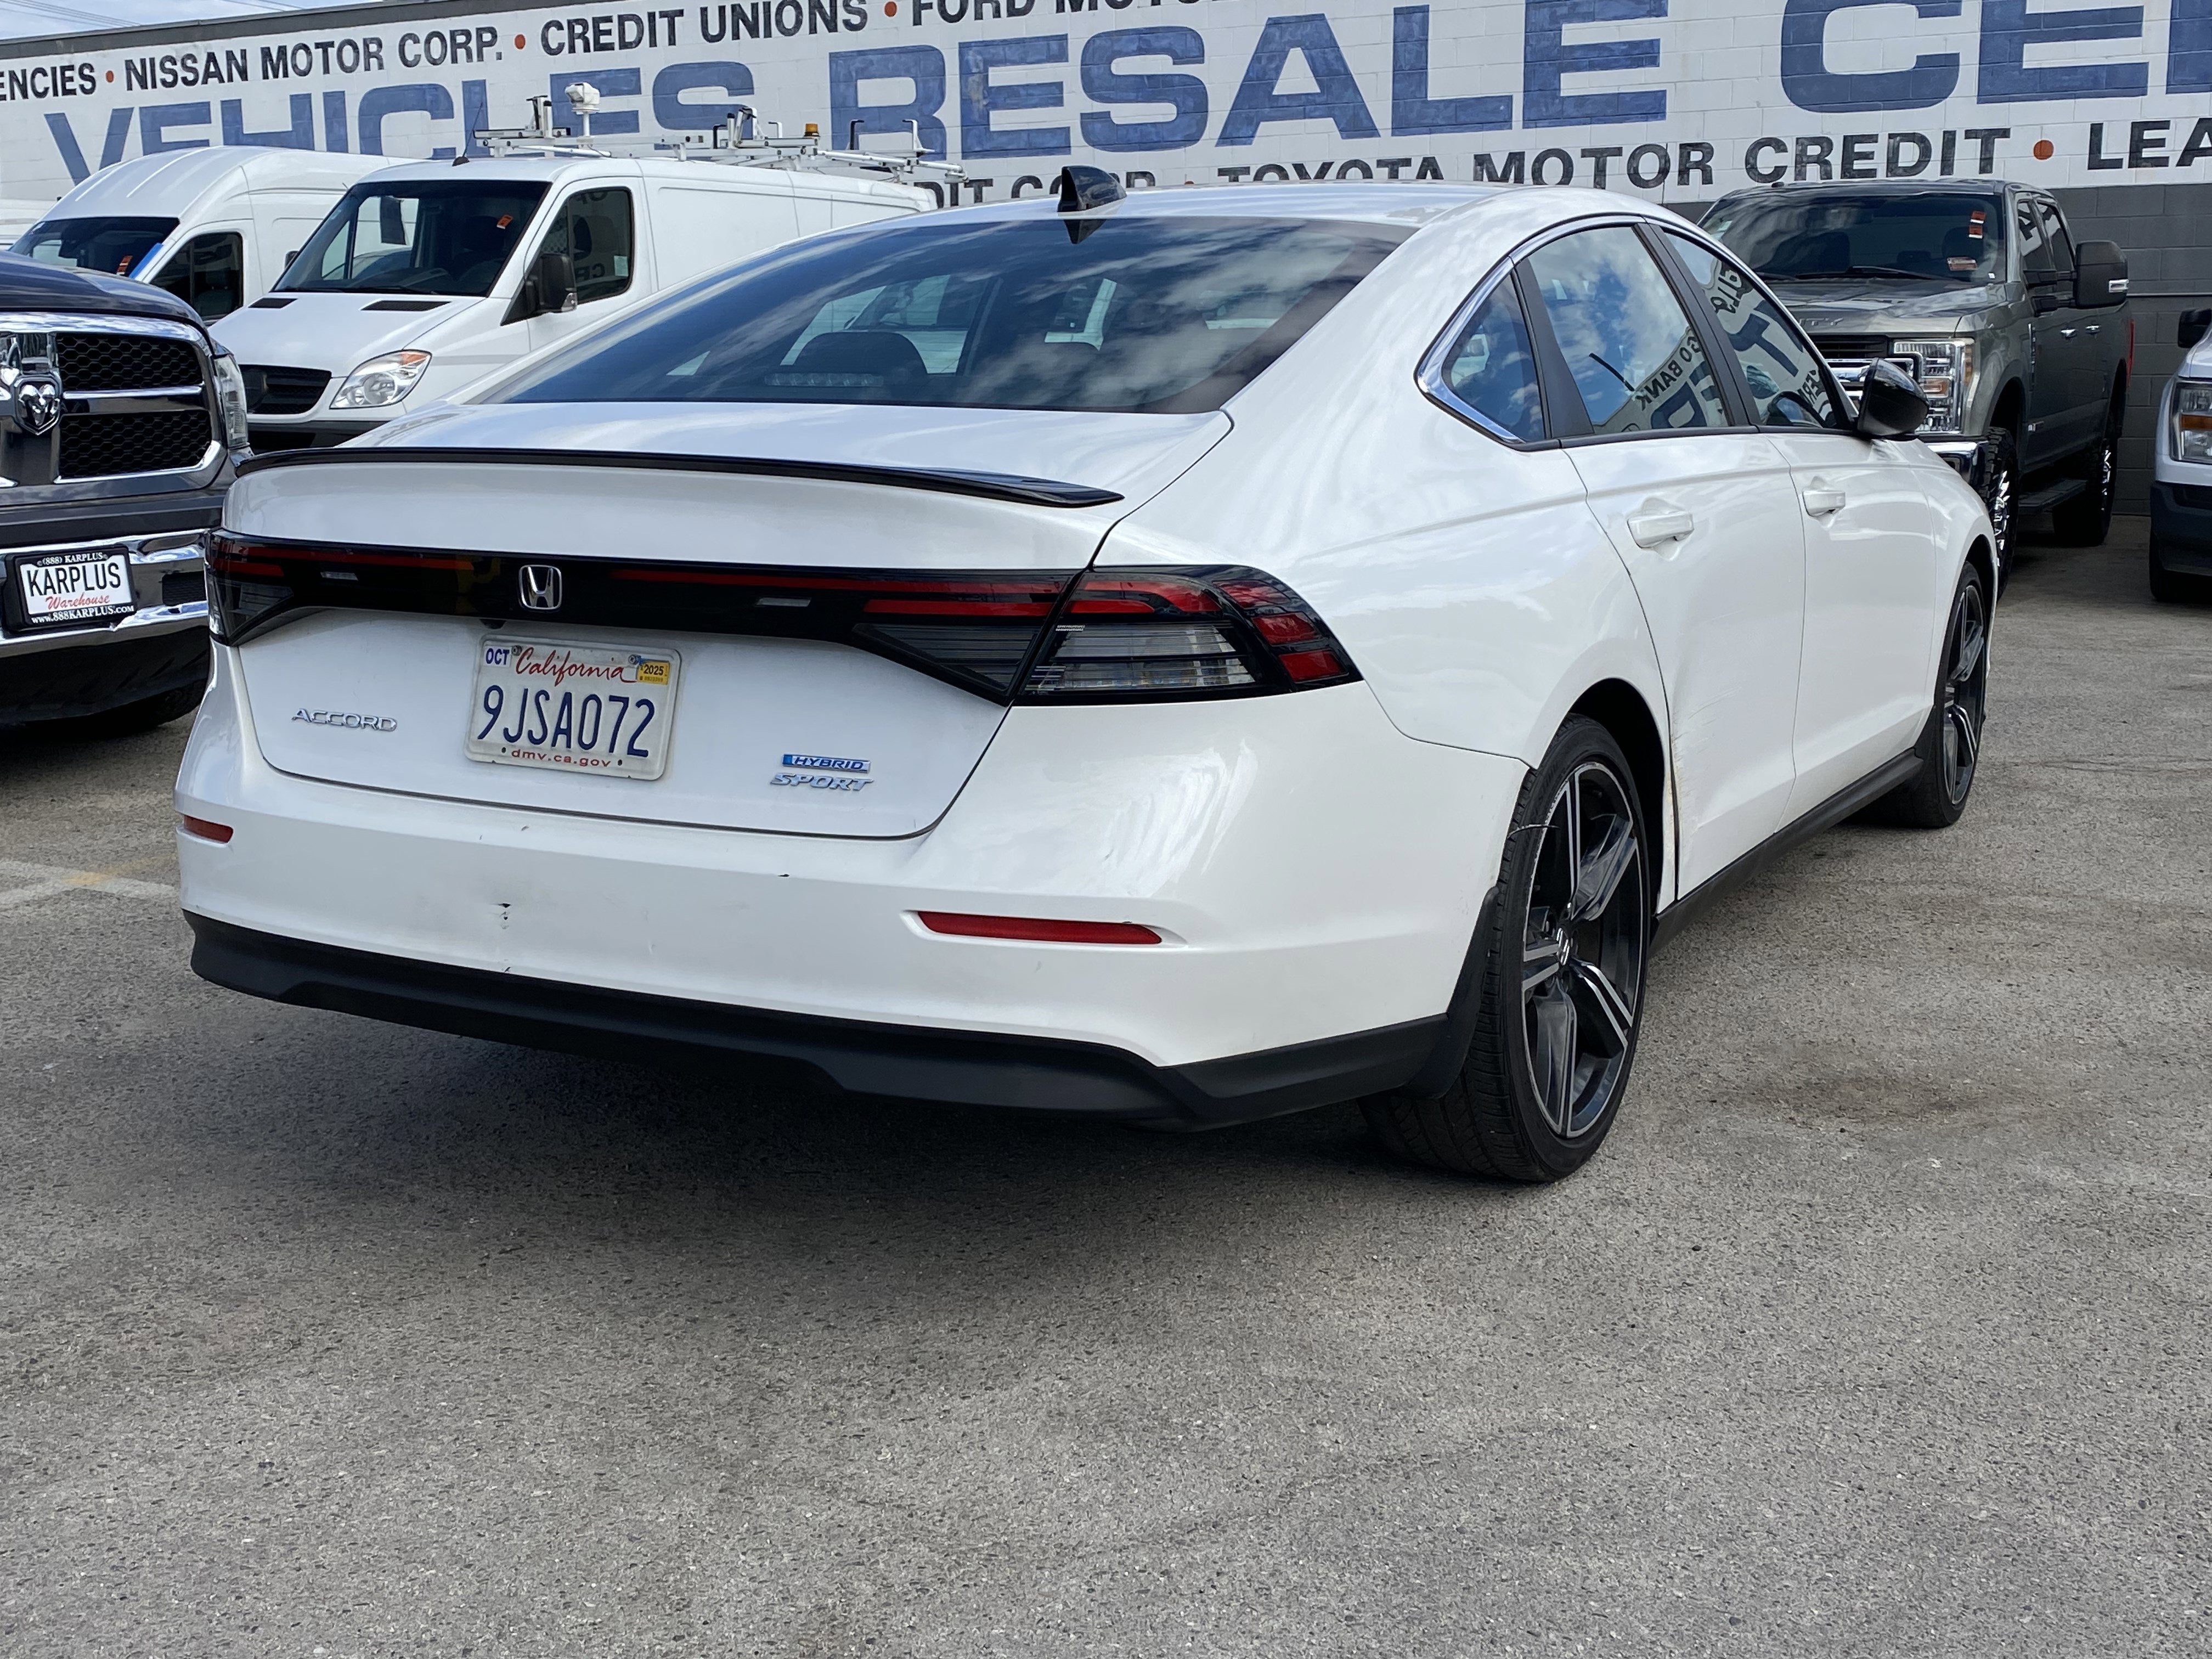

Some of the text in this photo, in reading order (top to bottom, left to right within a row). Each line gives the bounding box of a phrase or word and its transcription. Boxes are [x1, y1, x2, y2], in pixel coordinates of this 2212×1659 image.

[540, 0, 868, 55] CREDIT UNIONS
[124, 26, 502, 92] NISSAN MOTOR CORP.
[830, 0, 1667, 160] RESALE
[1474, 142, 1714, 189] MOTOR
[1745, 127, 2011, 183] CREDIT
[65, 552, 103, 563] KARPLUS
[27, 562, 121, 597] KARPLUS
[45, 592, 110, 610] Warehouse
[486, 648, 510, 665] OCT
[516, 646, 637, 687] California
[644, 664, 664, 675] 2025
[291, 708, 397, 731] ACCORD
[478, 685, 655, 758] 9JSA072
[512, 749, 611, 767] dmv.ca.gov
[795, 757, 864, 770] HYBRID
[770, 772, 873, 792] SPORT
